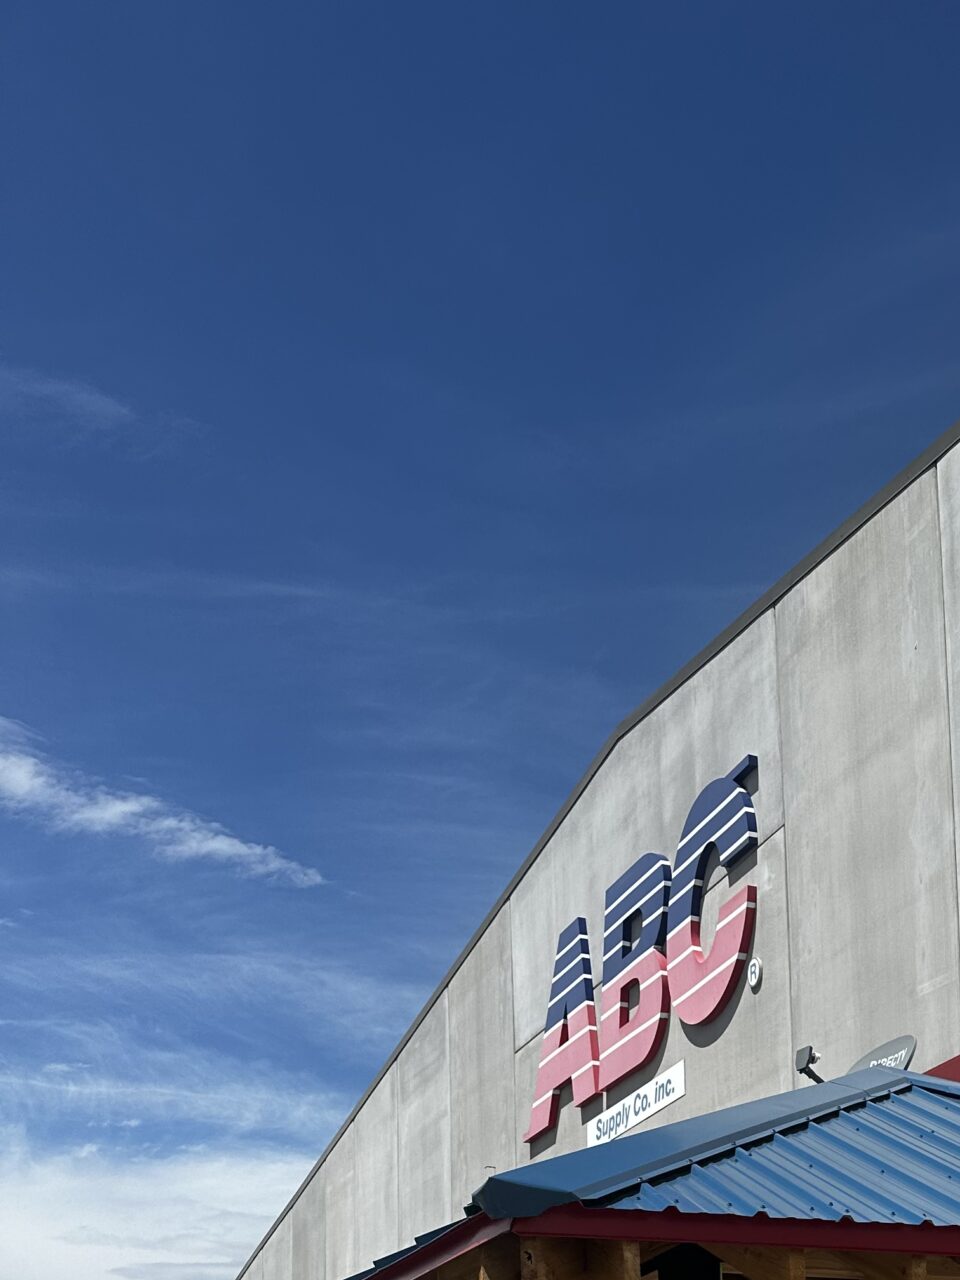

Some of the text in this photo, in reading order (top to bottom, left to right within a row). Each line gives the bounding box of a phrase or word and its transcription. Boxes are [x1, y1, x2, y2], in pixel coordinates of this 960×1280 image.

[523, 754, 758, 1143] ABC
[596, 1079, 675, 1140] Supply Co. inc.
